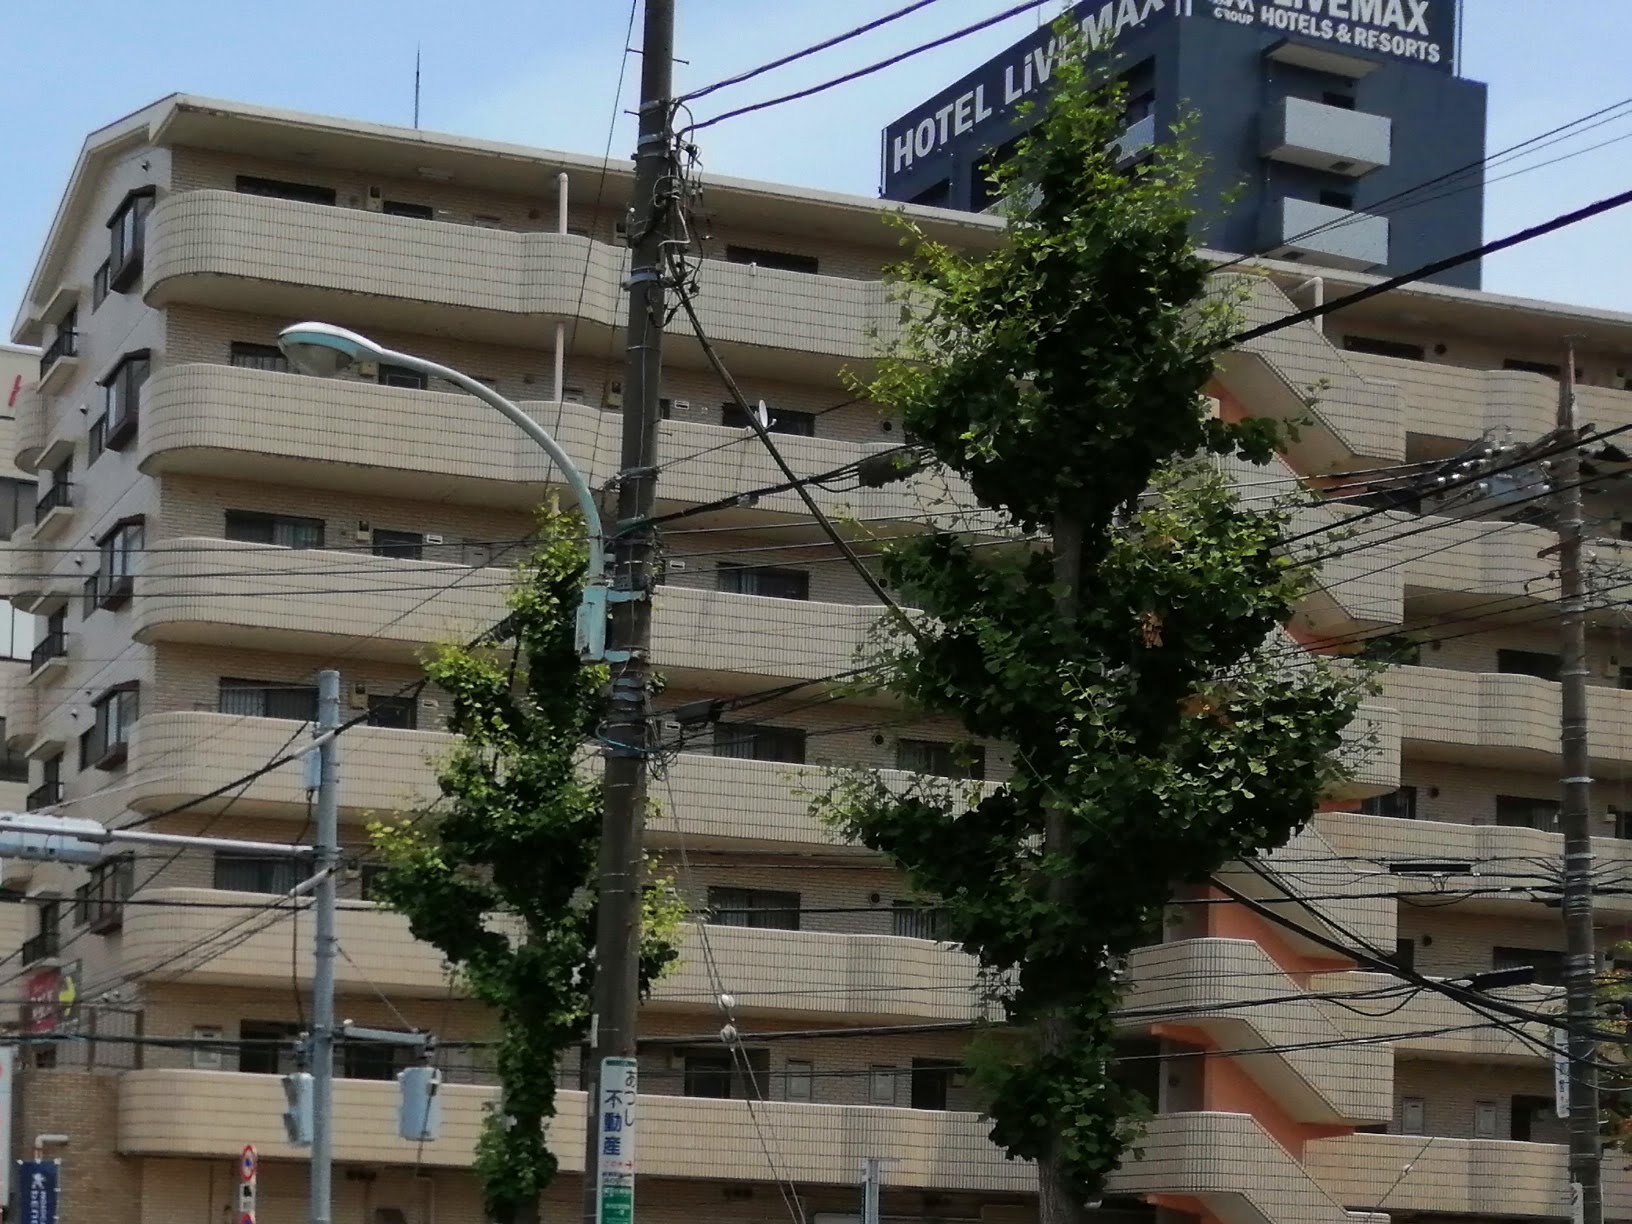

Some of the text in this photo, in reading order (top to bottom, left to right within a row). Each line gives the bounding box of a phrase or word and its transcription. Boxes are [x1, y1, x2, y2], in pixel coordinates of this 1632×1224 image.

[893, 84, 993, 174] HOTEL
[602, 1090, 623, 1156] 不動産
[624, 1070, 636, 1127] あつし
